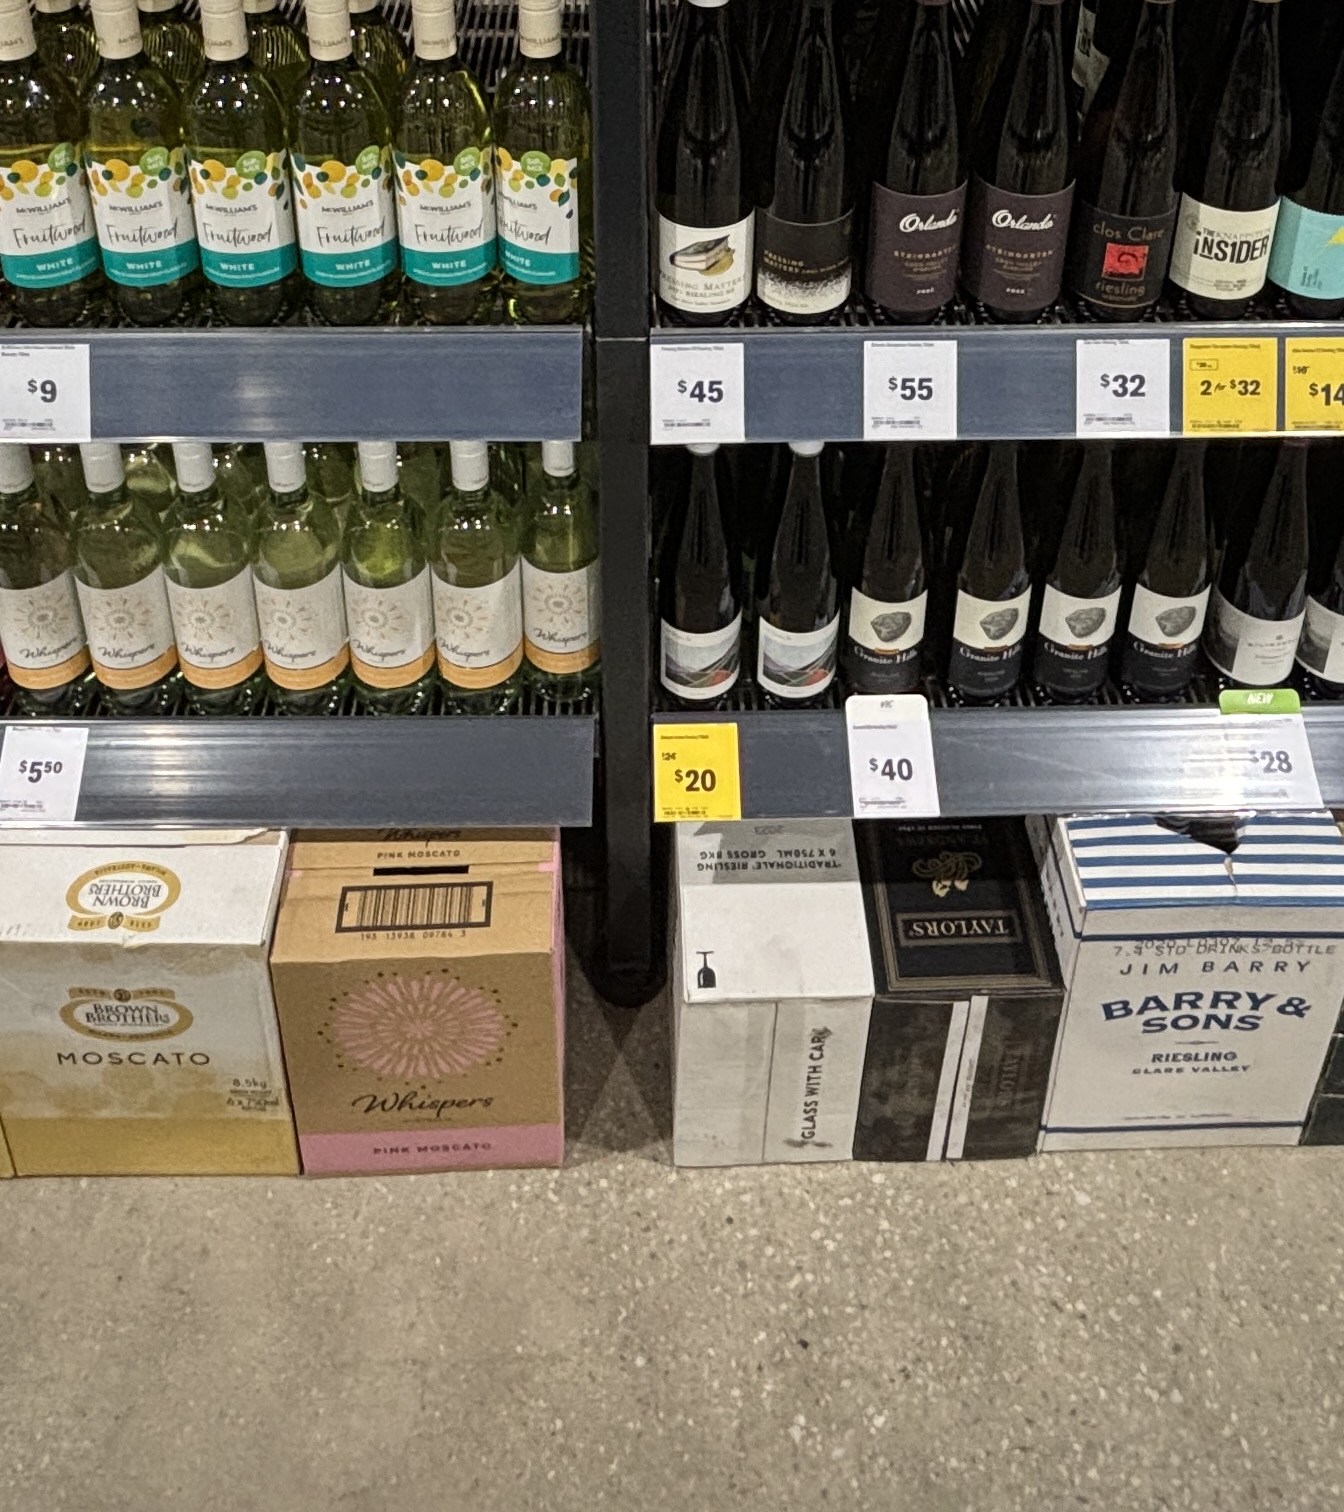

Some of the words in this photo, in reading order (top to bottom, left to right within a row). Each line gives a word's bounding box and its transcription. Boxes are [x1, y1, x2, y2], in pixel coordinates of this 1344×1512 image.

[991, 209, 1056, 232] Orlando
[1093, 222, 1122, 239] clos
[12, 218, 88, 249] Fruitwood
[316, 222, 387, 247] Fruitwood
[35, 256, 74, 272] WHITE
[335, 258, 372, 272] WHITE
[27, 378, 58, 404] $9
[677, 378, 724, 404] $45
[887, 375, 934, 401] $55
[1099, 373, 1146, 398] $32
[1200, 380, 1212, 396] 2
[1229, 379, 1261, 396] $32
[1247, 693, 1274, 705] NEW
[869, 756, 914, 783] $40
[674, 768, 717, 793] $20
[908, 920, 1010, 937] TAYLORS
[1120, 961, 1179, 976] JIM
[1202, 960, 1311, 974] BARRY
[92, 1001, 158, 1017] BROWN
[1101, 990, 1278, 1021] BARRY
[1276, 996, 1311, 1018] &
[1141, 1014, 1265, 1034] SONS
[57, 1051, 211, 1067] MOSCATO
[1151, 1051, 1238, 1063] RIESLING
[806, 1060, 822, 1092] WITH
[1192, 1065, 1250, 1073] VALLEY
[350, 1091, 494, 1118] Whispers
[801, 1093, 817, 1140] GLASS
[372, 1145, 411, 1156] PINK
[415, 1141, 493, 1154] MOSCATO
